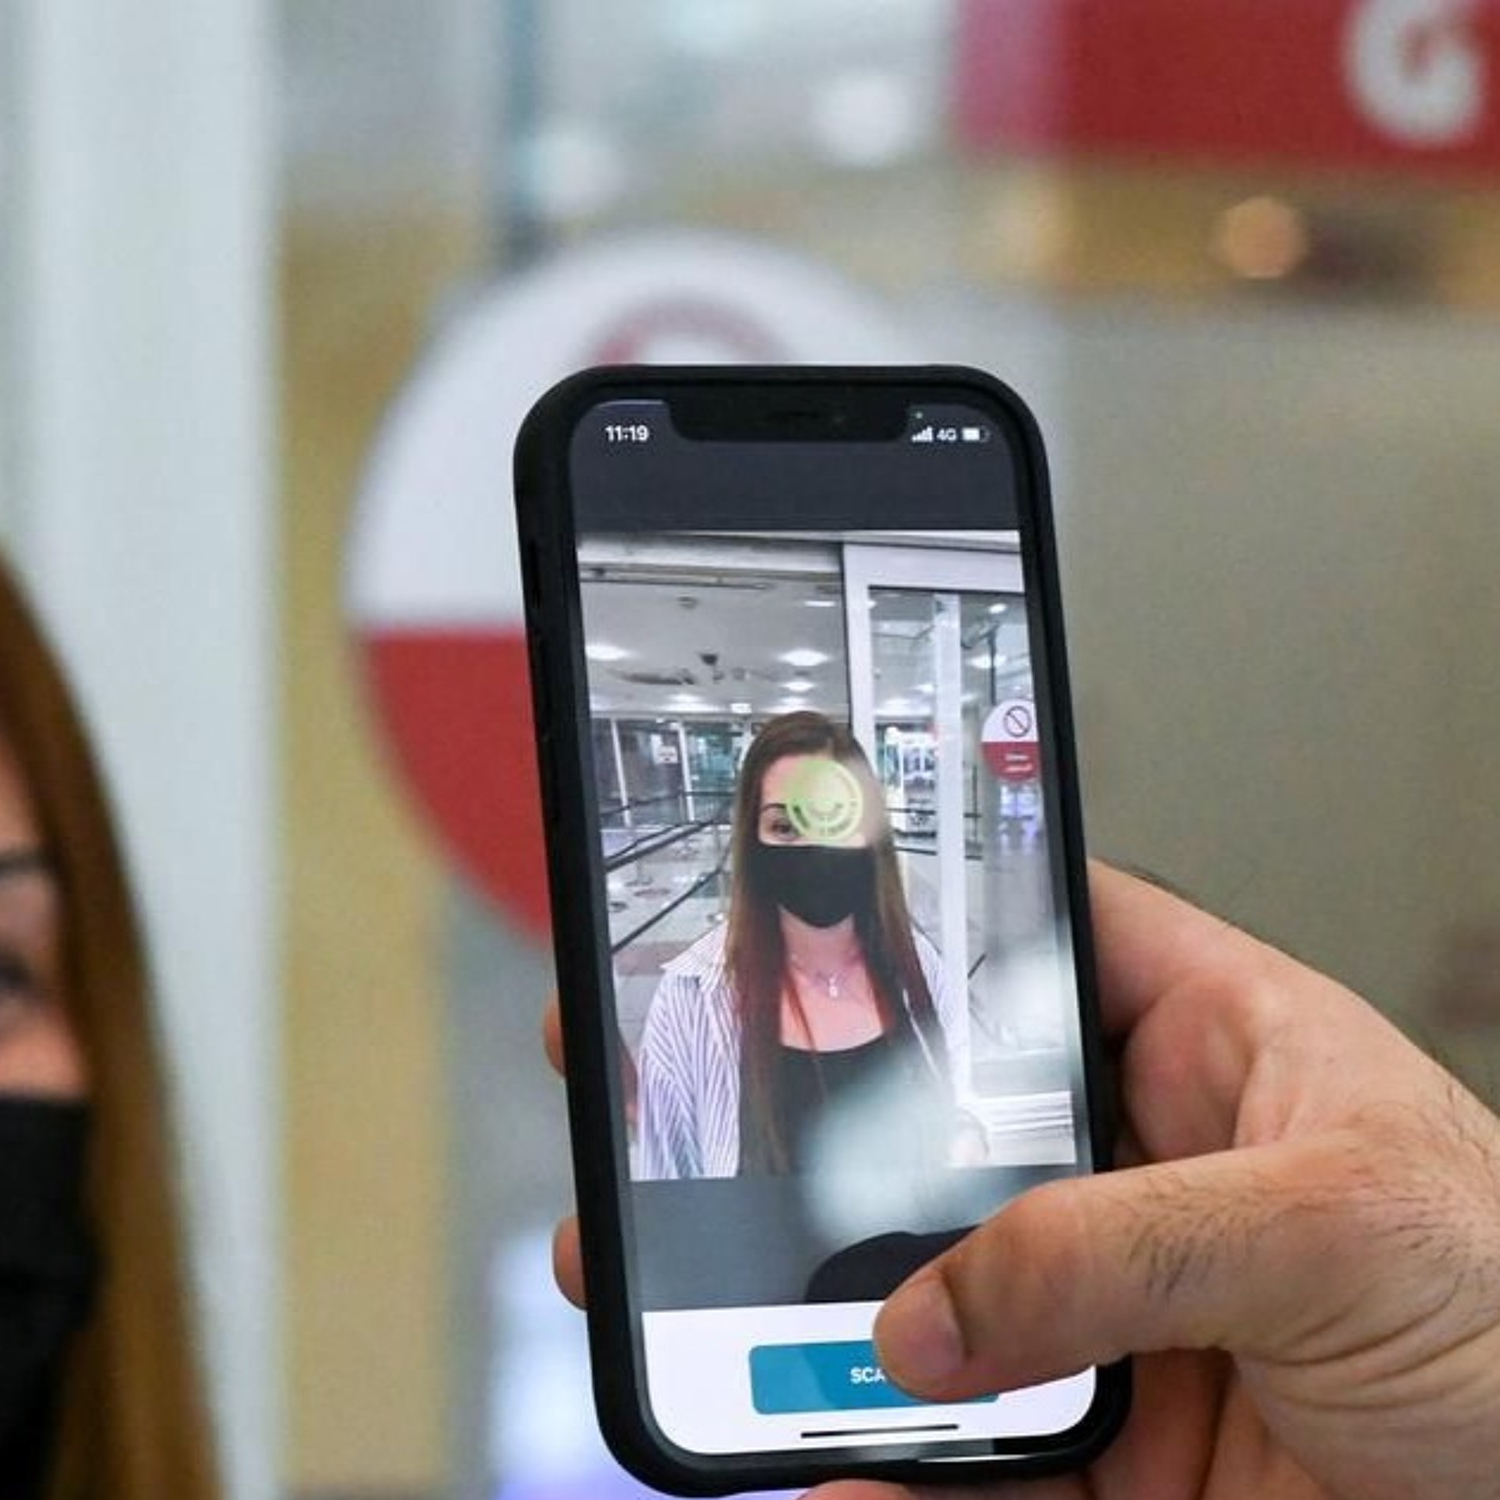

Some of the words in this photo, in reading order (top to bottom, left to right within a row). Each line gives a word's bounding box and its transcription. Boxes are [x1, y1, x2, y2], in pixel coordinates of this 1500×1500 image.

[605, 425, 649, 442] 11:19
[936, 427, 957, 441] 4G
[850, 1366, 886, 1384] SCA
